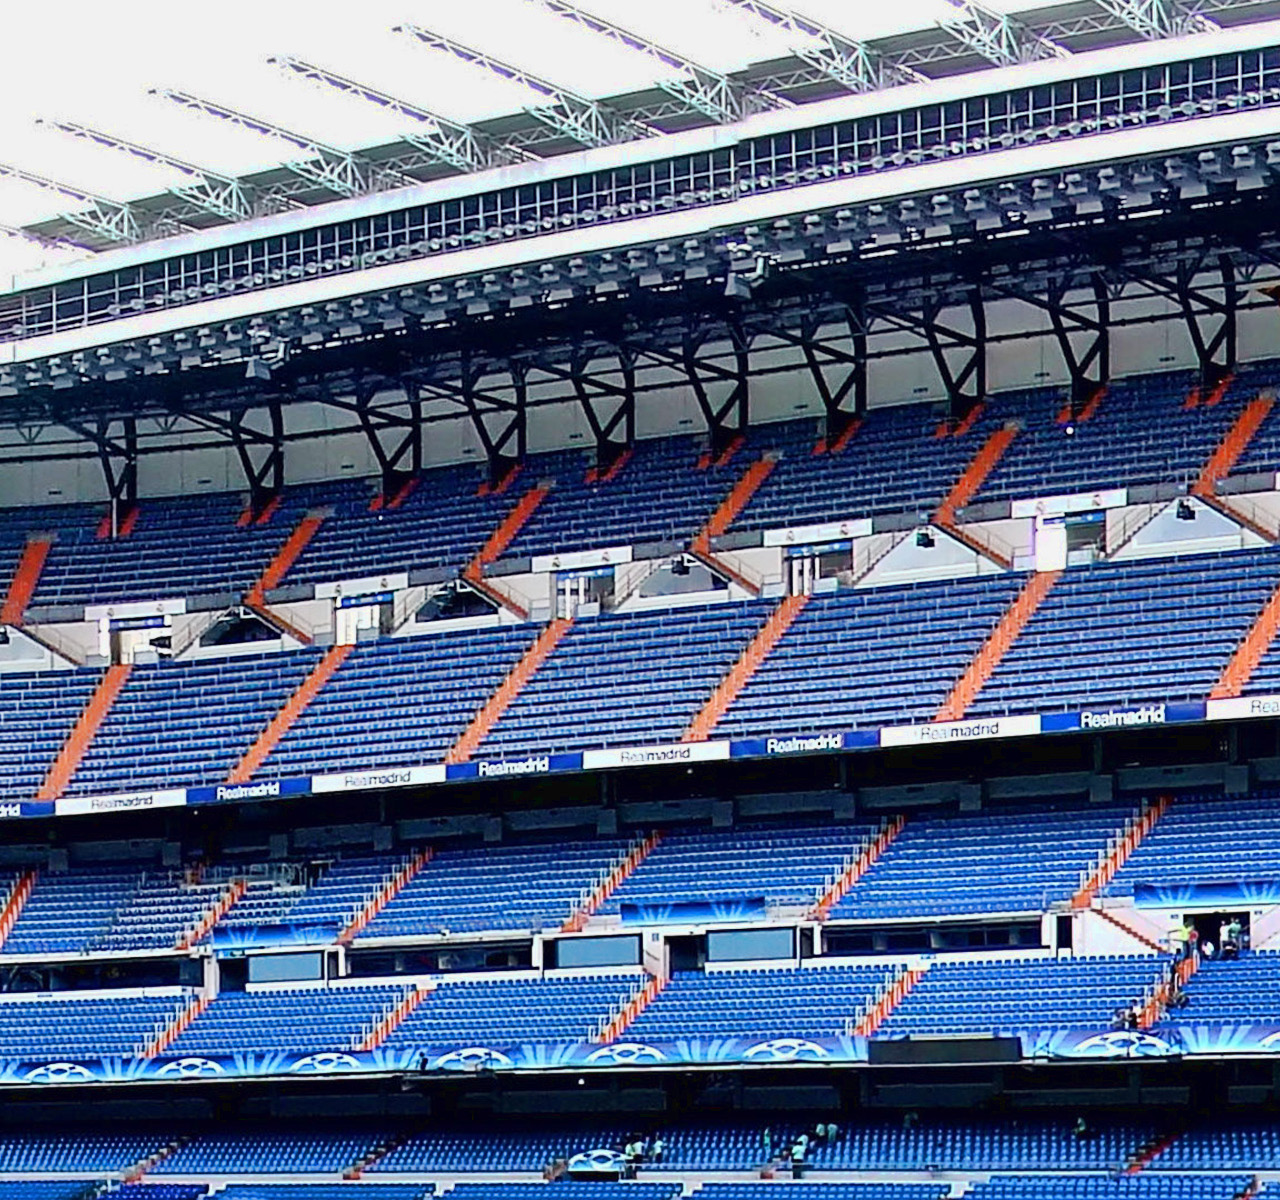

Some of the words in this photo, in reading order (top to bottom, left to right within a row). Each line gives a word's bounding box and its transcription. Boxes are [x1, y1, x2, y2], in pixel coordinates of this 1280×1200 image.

[1081, 705, 1165, 729] Realmadrid
[920, 720, 999, 740] Realmadrid
[767, 734, 842, 752] Realmadrid
[620, 746, 690, 763] Realmadrid
[479, 757, 549, 774] Realmadrid
[344, 771, 411, 788] Realmadrid
[216, 782, 279, 799] Realmadrid
[92, 793, 152, 811] Realmadrid
